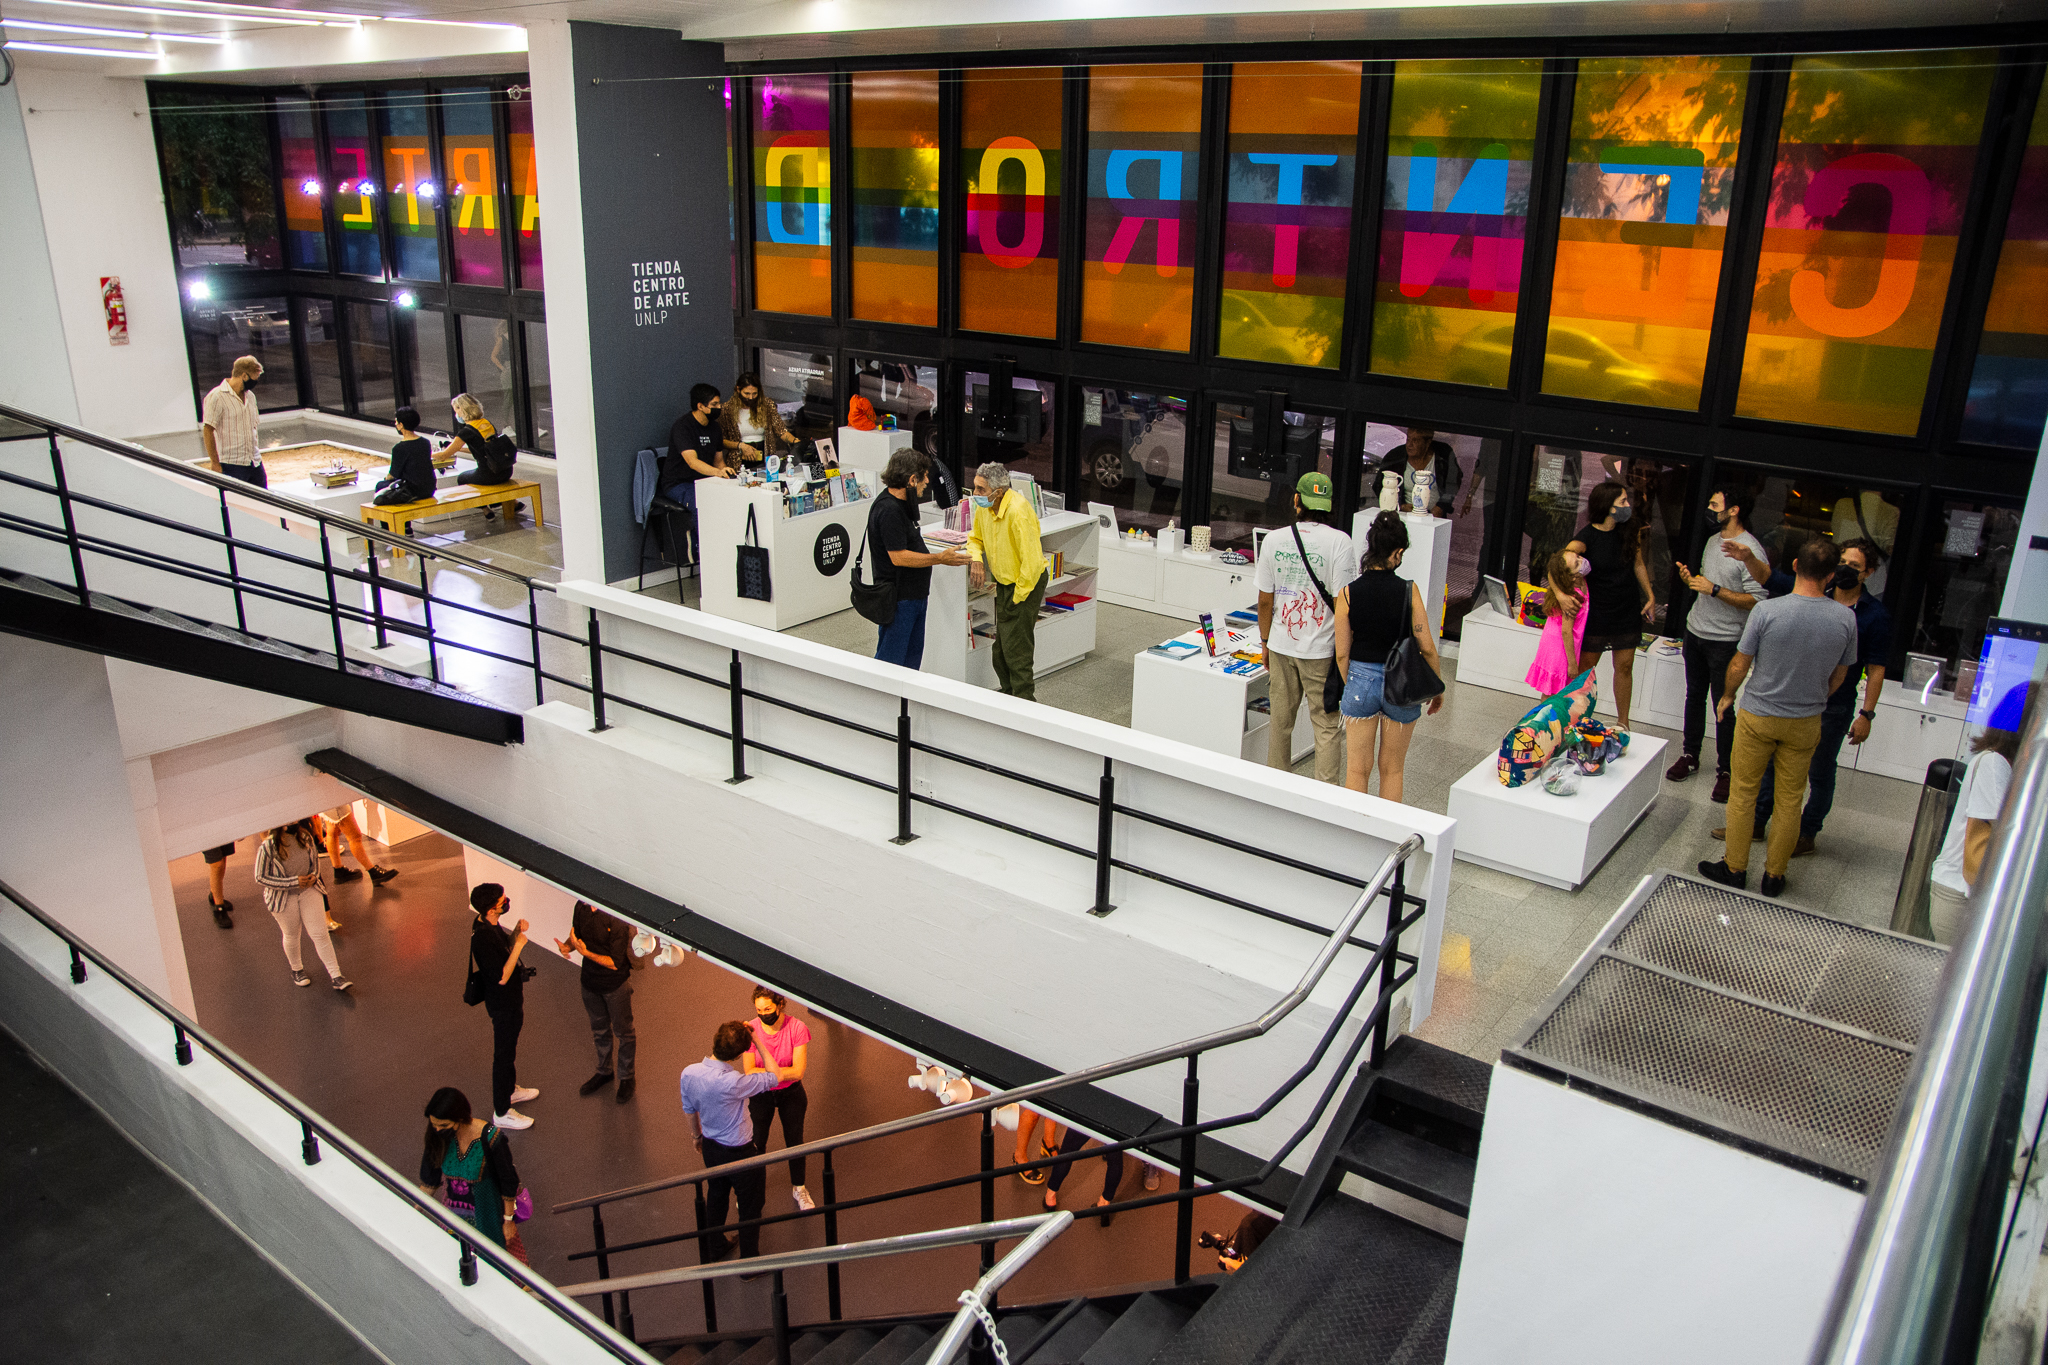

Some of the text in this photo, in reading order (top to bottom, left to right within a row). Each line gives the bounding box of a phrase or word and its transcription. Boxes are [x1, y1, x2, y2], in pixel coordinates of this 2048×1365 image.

[631, 260, 682, 277] TIENDA
[633, 276, 685, 294] CENTRO
[634, 292, 690, 310] DE ARTE
[635, 310, 668, 327] UNLP
[1313, 484, 1328, 495] U
[822, 535, 840, 545] TIENDA
[822, 541, 842, 552] CENTRO
[830, 547, 843, 557] ARTE
